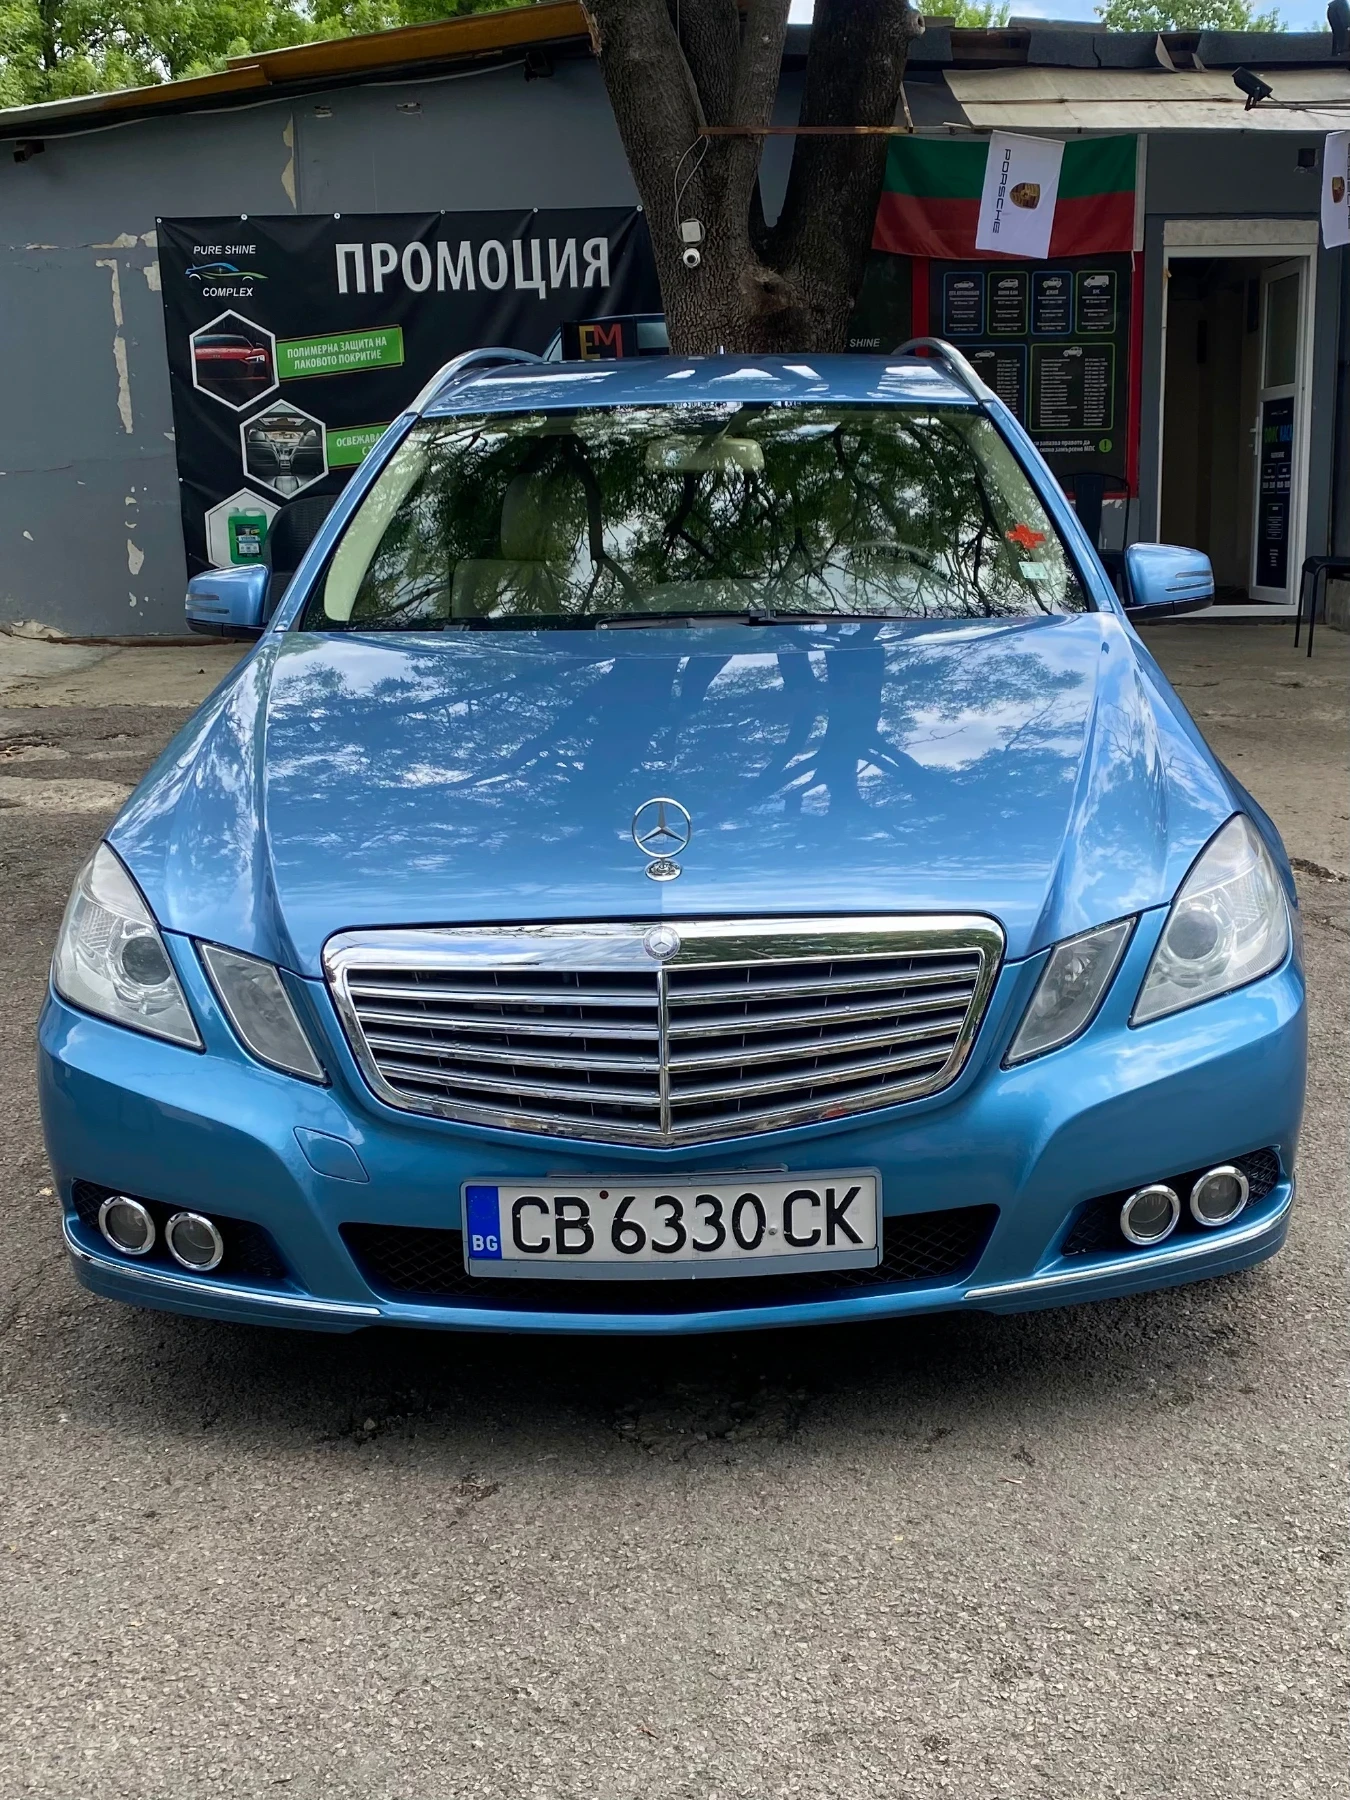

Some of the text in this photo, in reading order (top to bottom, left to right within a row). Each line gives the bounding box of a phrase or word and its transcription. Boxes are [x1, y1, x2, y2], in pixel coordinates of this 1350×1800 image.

[992, 148, 1011, 234] PORSCHE
[193, 244, 256, 255] PURE SHINE
[335, 237, 610, 300] ПРОМОЦИЯ
[202, 287, 253, 297] COMPLEX
[287, 337, 387, 359] ПОЛИМЕРНА ЗАЩИТА НА
[849, 338, 880, 348] SHINE
[294, 351, 382, 370] ЛАКОВОТО ПОКРИТИЕ
[511, 1186, 864, 1255] CB 6330 CK
[472, 1234, 498, 1252] BG
